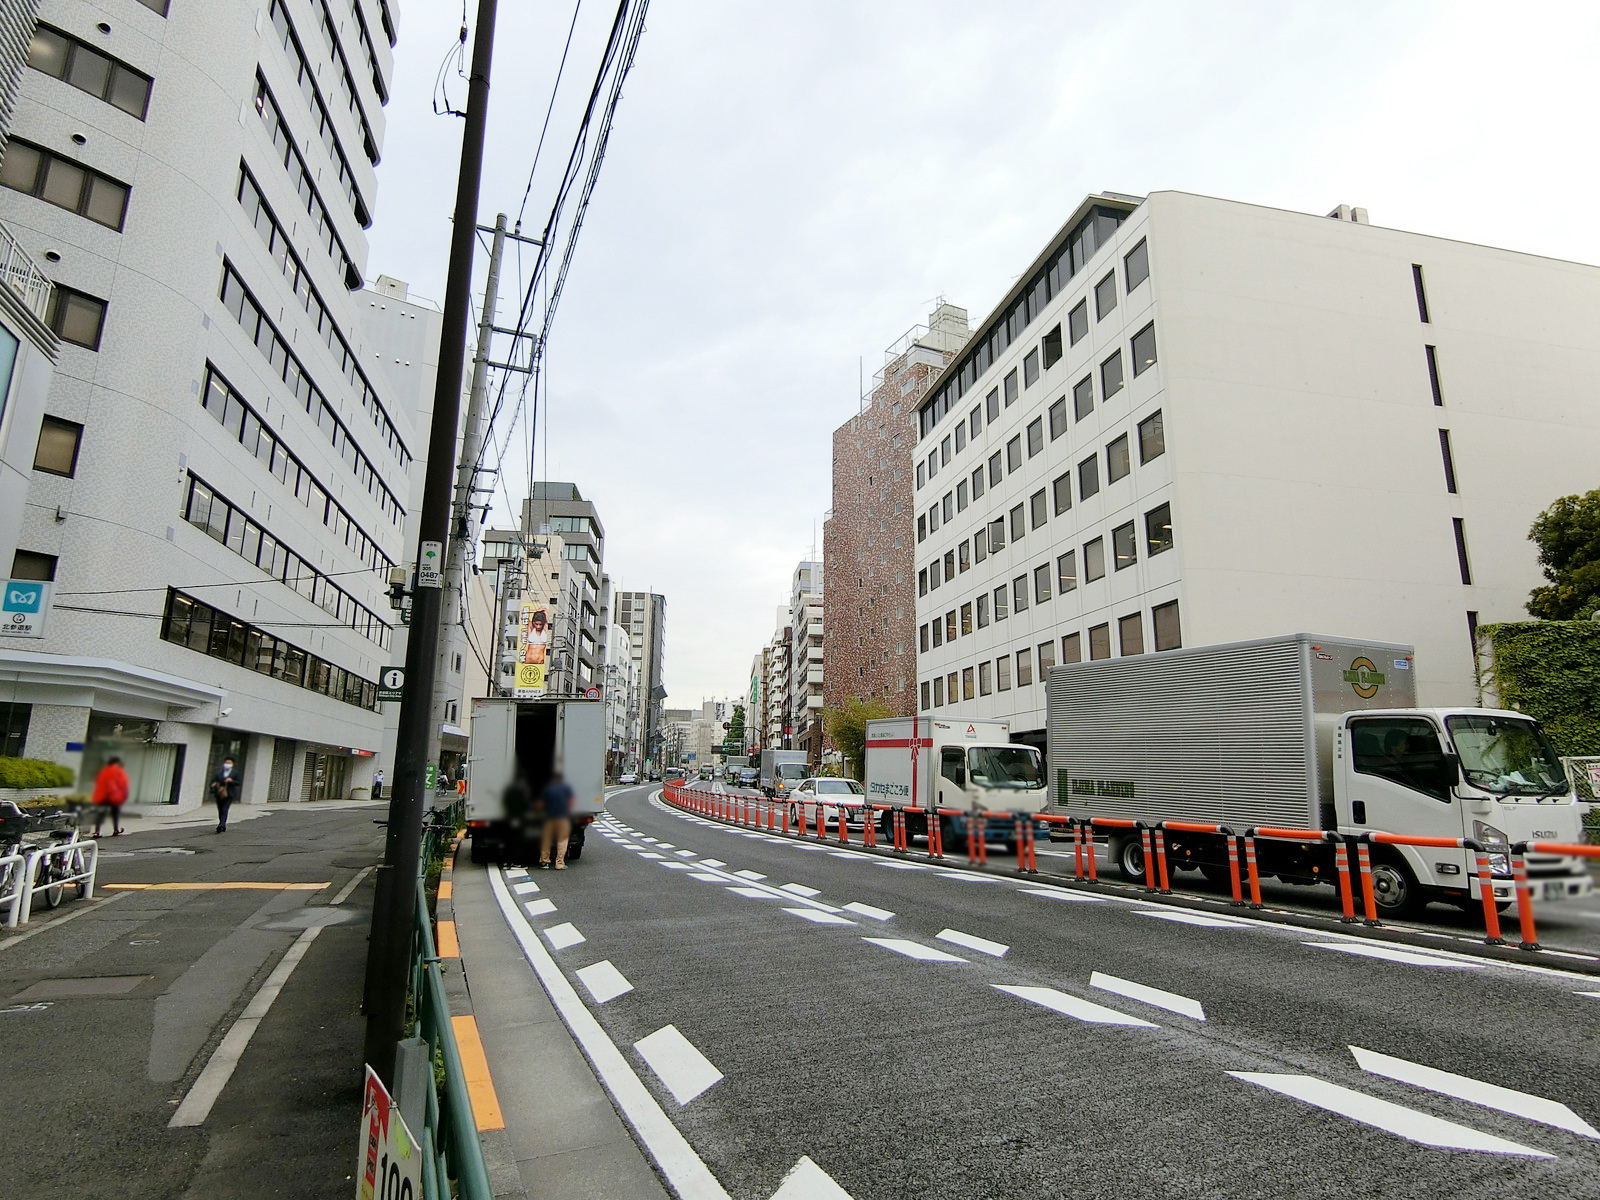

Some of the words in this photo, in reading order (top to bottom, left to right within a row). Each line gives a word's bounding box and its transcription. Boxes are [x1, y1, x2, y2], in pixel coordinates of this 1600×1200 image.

[420, 571, 438, 579] 0487
[870, 781, 909, 797] タカセまごころ便
[1532, 830, 1558, 839] ISUZU
